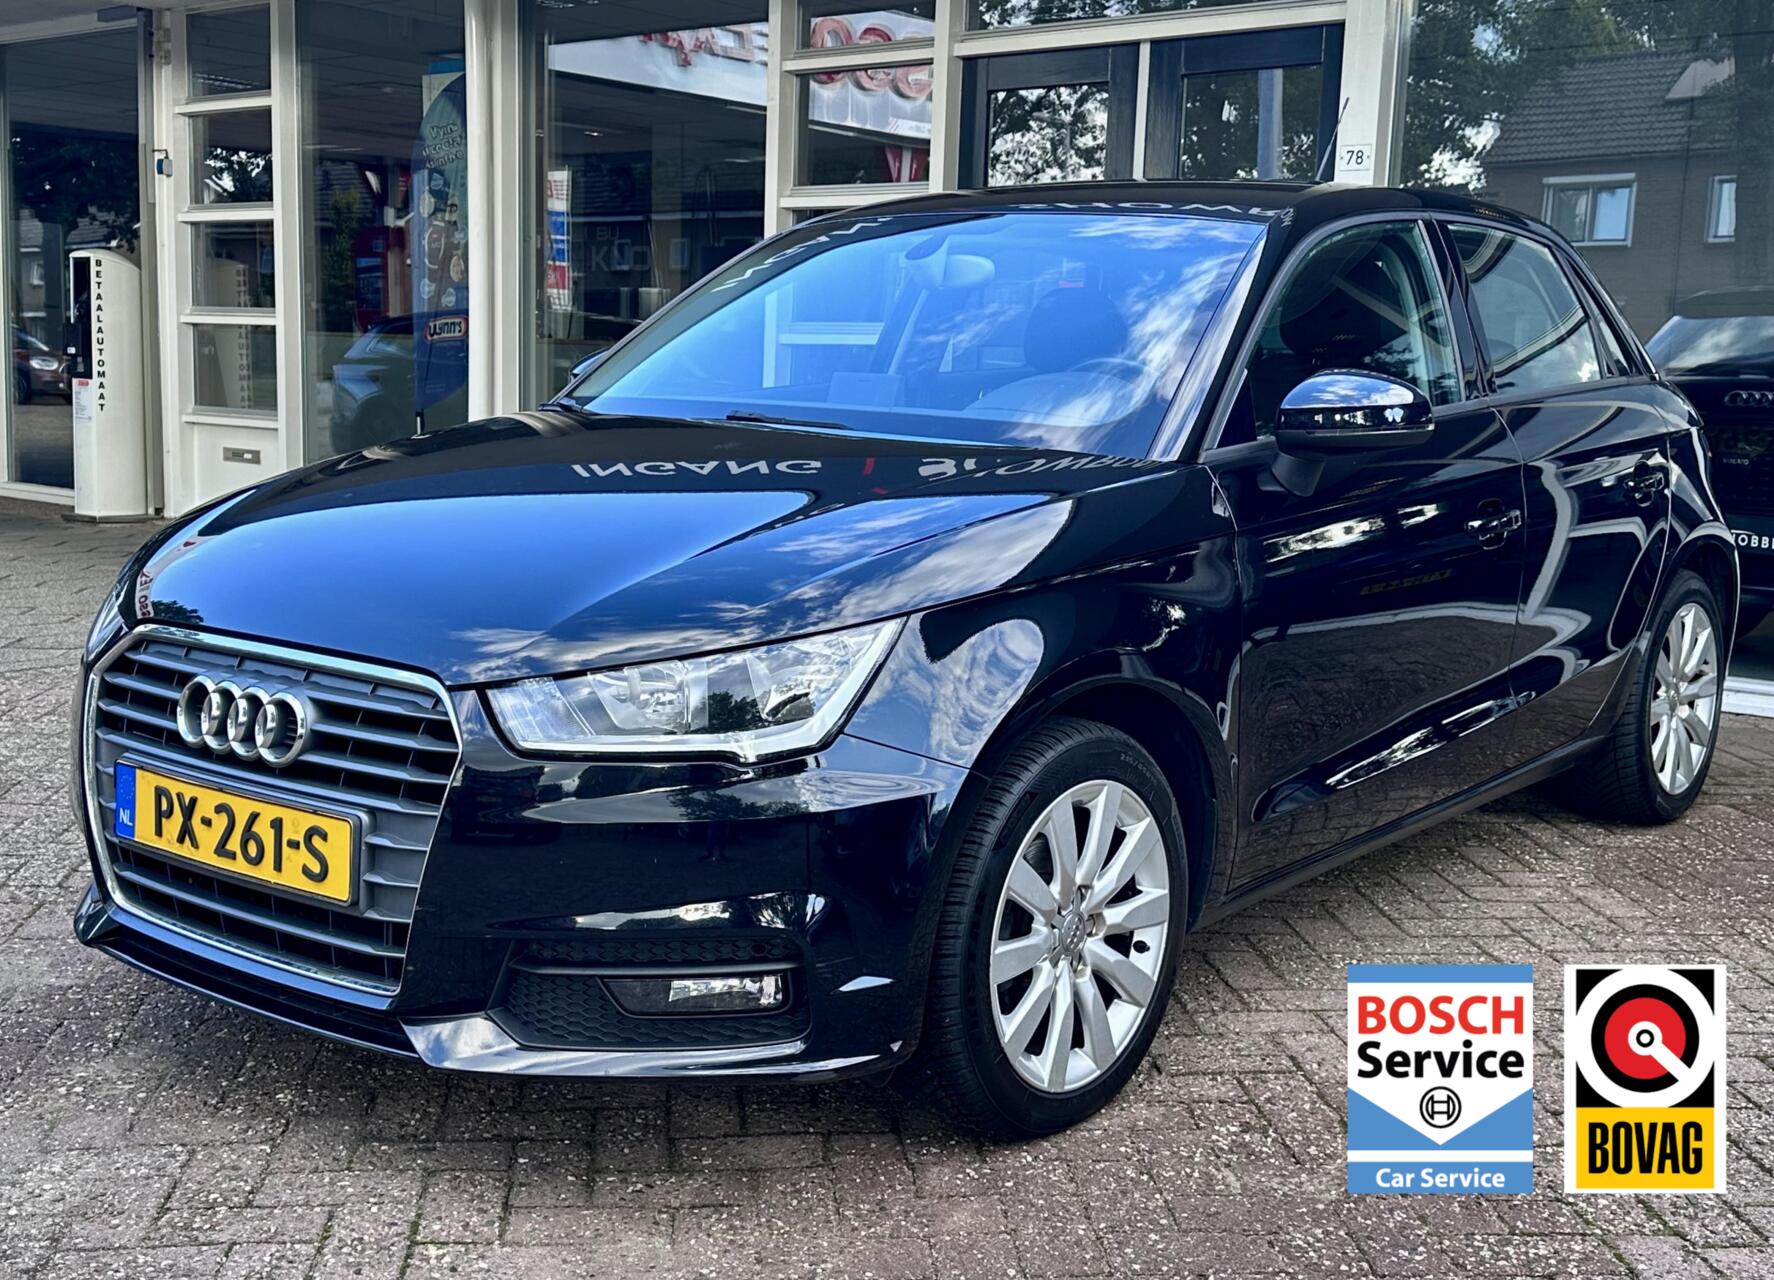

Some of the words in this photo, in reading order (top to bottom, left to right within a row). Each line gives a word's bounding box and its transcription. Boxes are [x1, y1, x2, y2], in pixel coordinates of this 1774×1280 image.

[1346, 150, 1364, 165] 78
[95, 259, 106, 412] BETAALAUTOMAAT
[119, 808, 133, 828] NL
[155, 786, 328, 883] PX-261-S
